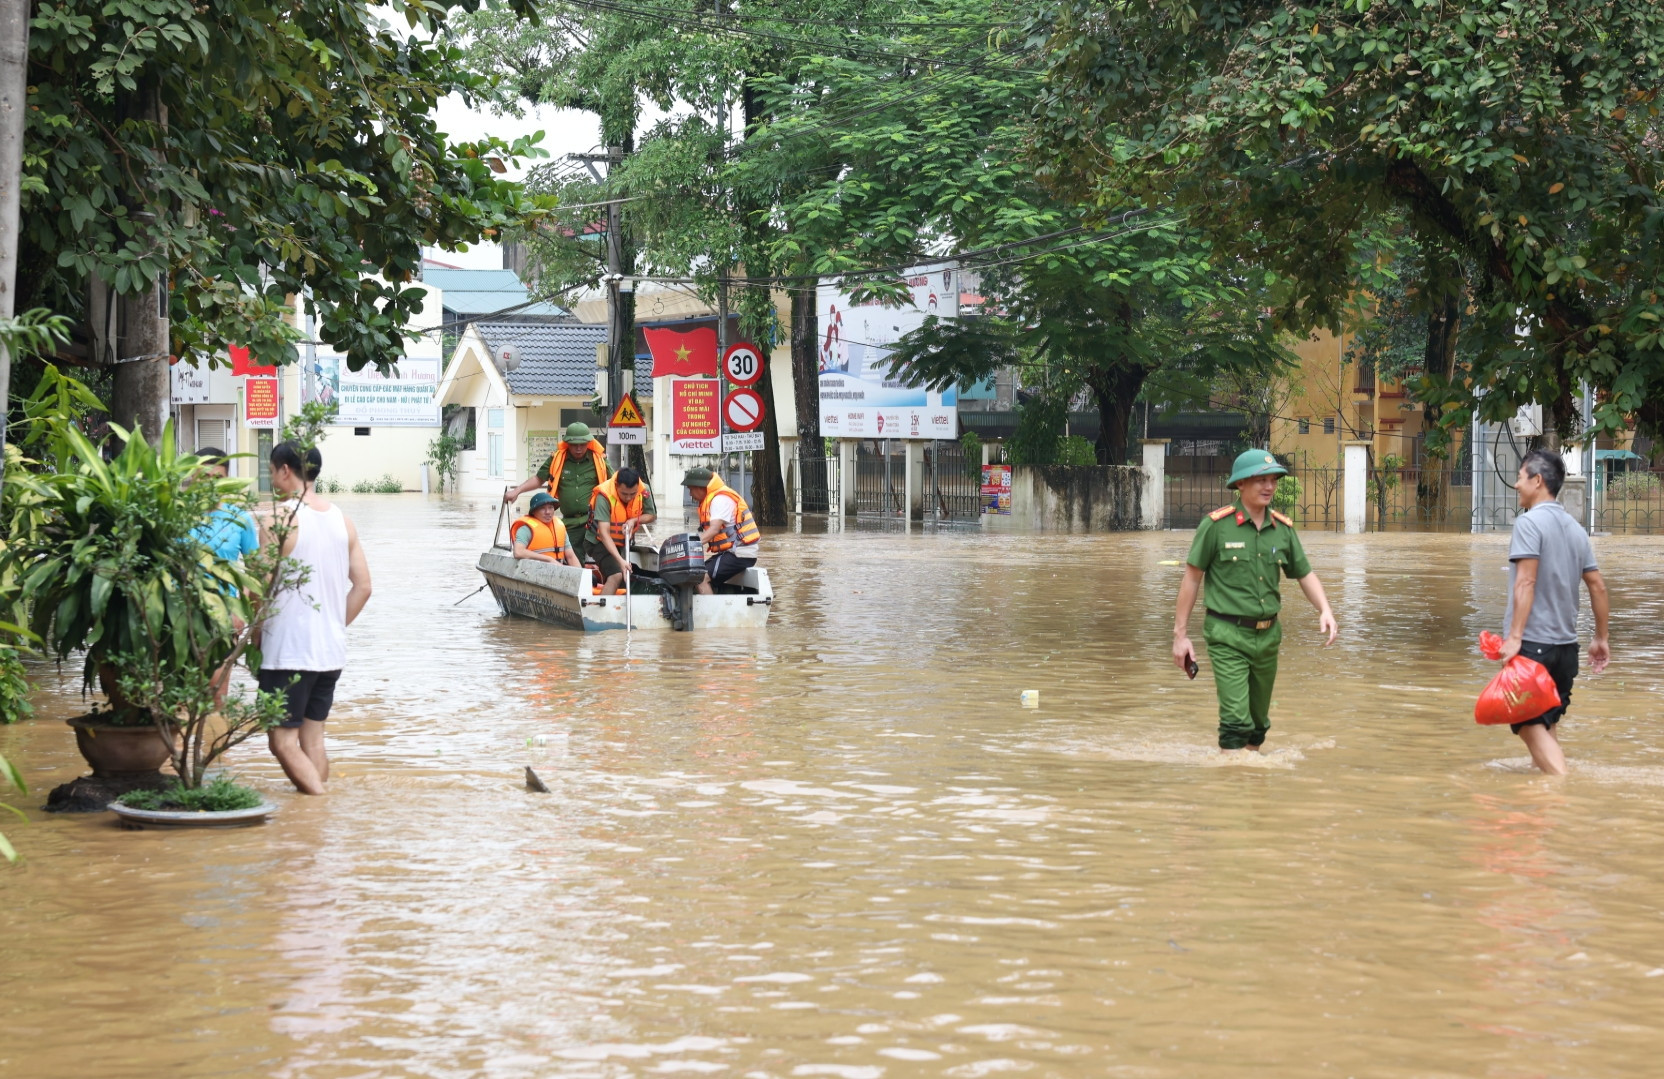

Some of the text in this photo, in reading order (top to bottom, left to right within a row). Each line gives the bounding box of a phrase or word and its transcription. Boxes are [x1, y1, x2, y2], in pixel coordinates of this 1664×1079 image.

[732, 355, 752, 375] 30
[824, 415, 838, 424] viettel
[931, 415, 949, 425] viettel
[666, 543, 684, 555] YAMAHA
